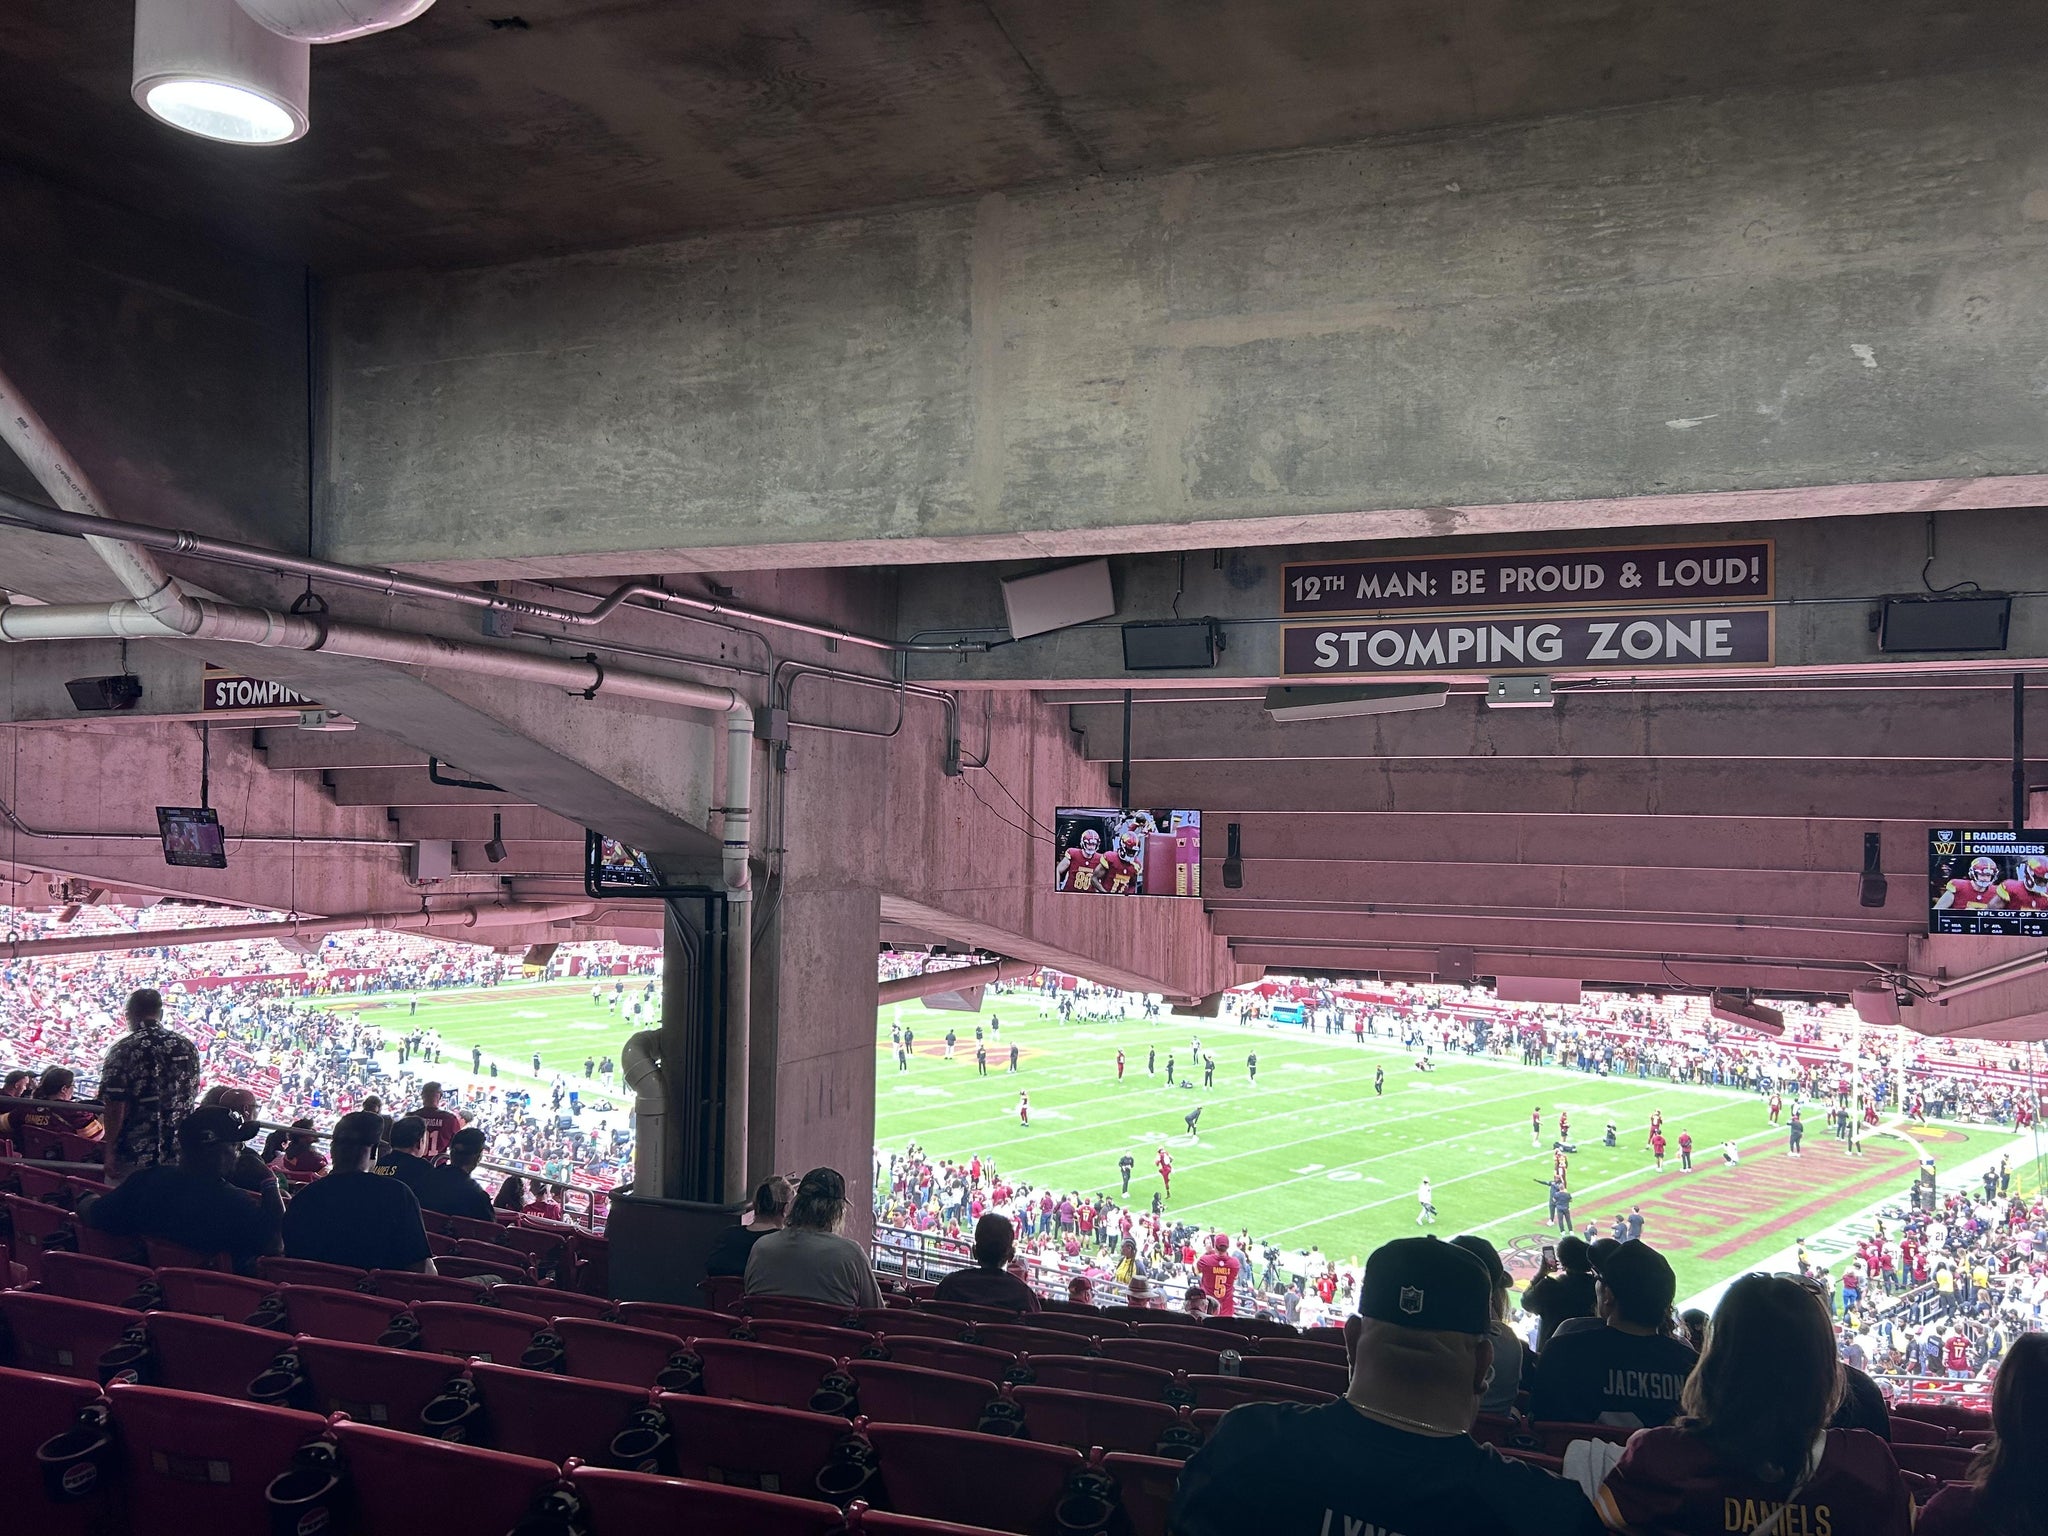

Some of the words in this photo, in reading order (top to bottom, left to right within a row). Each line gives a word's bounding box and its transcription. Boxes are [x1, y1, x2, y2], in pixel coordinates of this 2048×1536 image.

[1291, 575, 1345, 602] 12TH
[1356, 570, 1438, 600] MAN:
[1451, 568, 1486, 595] BE
[1499, 564, 1605, 593] PROUD
[1619, 561, 1642, 589] &
[1657, 556, 1760, 587] LOUD!
[1313, 623, 1563, 668] STOMPING
[1585, 618, 1733, 660] ZONE
[215, 680, 312, 706] STOMPIN
[1972, 832, 2017, 841] RAIDERS
[1972, 845, 2045, 854] COMMANDERS
[1935, 1231, 1944, 1241] 21
[1213, 1275, 1227, 1298] 5
[1954, 1346, 1964, 1358] 17
[1603, 1369, 1685, 1400] JACKSON
[1724, 1496, 1832, 1536] DANIELS
